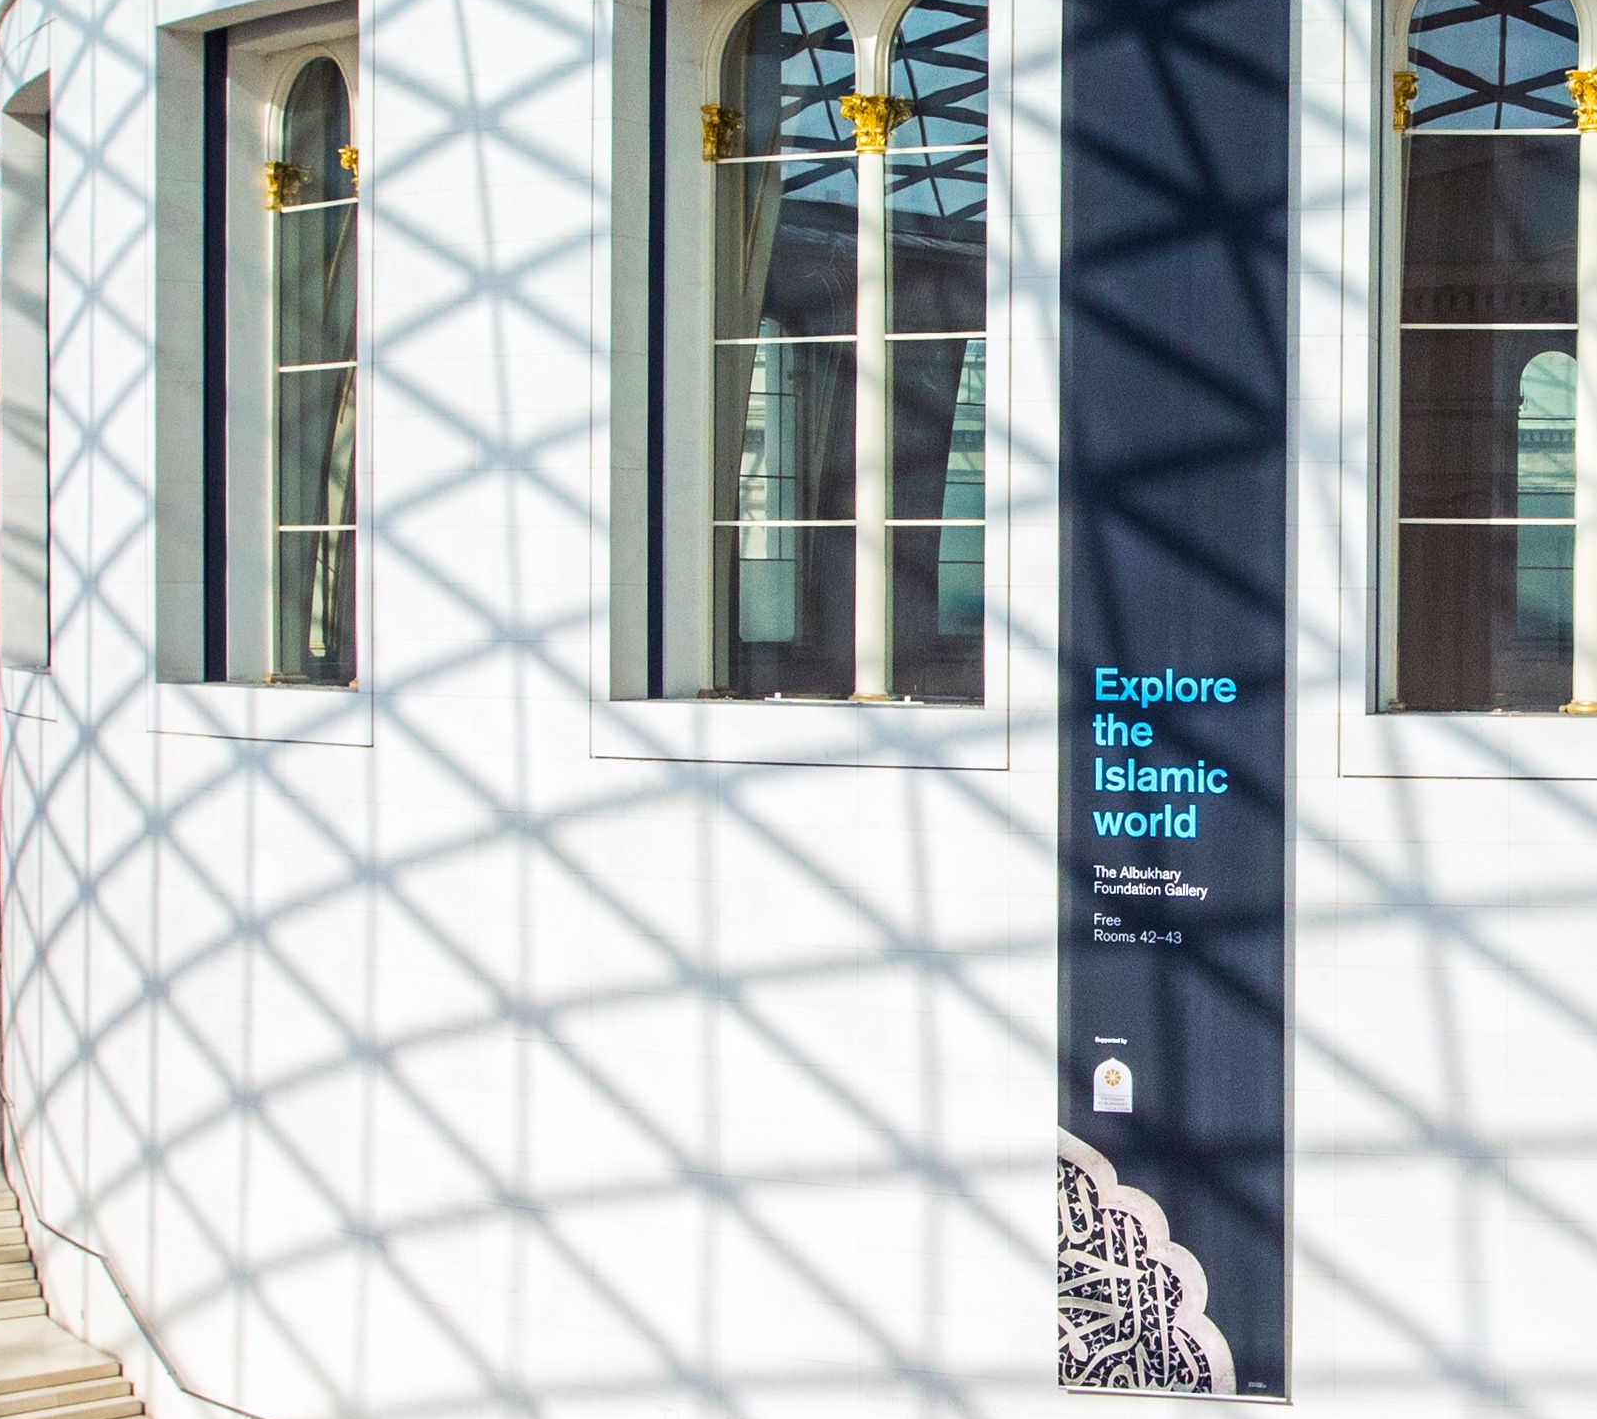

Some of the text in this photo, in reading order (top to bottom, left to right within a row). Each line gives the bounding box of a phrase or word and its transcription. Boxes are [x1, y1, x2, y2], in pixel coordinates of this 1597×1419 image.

[1094, 667, 1237, 708] Explore
[1092, 713, 1154, 747] the
[1094, 757, 1229, 794] Islamic
[1092, 803, 1197, 839] world
[1094, 865, 1181, 883] The Albukhary
[1094, 881, 1208, 900] Foundation Gallery
[1094, 913, 1121, 926] Free
[1094, 929, 1136, 943] Rooms
